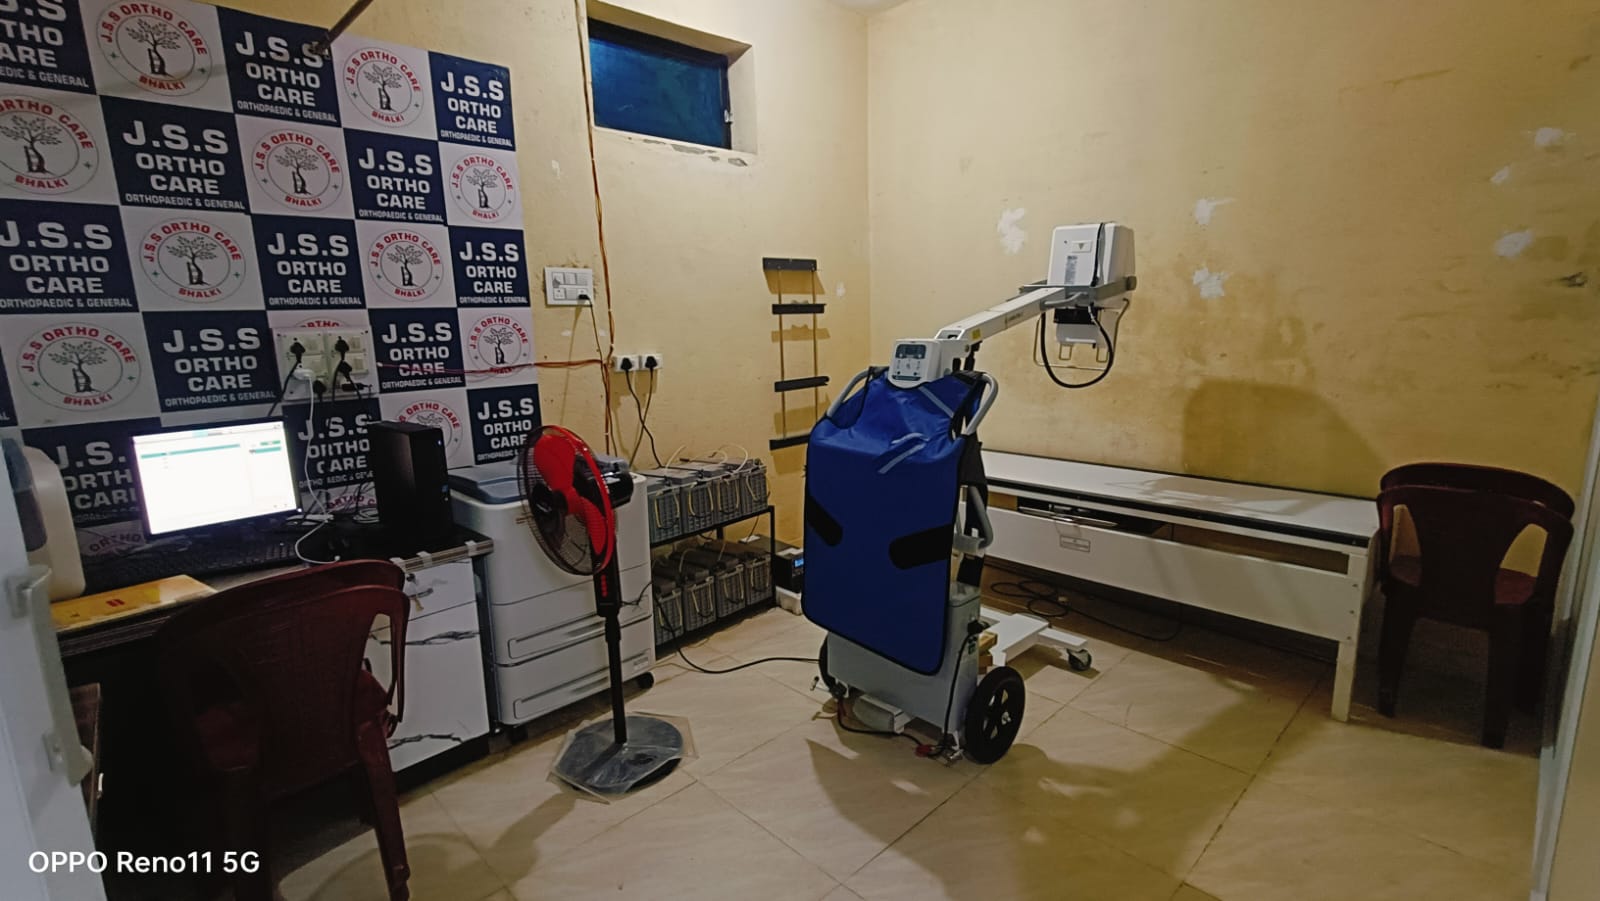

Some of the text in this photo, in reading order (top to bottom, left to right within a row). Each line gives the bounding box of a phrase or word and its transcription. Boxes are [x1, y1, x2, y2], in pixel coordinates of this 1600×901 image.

[0, 19, 63, 46] THO
[120, 4, 173, 21] ORTHO
[178, 21, 207, 55] CARE
[0, 42, 57, 68] ARE
[39, 71, 89, 88] GENERAL
[245, 62, 321, 89] ORTHO
[360, 51, 398, 64] ORTHO
[400, 64, 421, 92] CARE
[139, 75, 186, 90] BHALKI
[440, 72, 504, 101] J.S.S
[257, 84, 316, 107] CARE
[237, 100, 292, 116] ORTHOPAEDIC
[302, 109, 337, 122] GENERAL
[447, 97, 501, 118] ORTHO
[59, 114, 94, 149] CARE
[455, 116, 497, 133] CARE
[122, 120, 229, 154] J.S.S
[488, 137, 512, 147] GENERAL
[271, 132, 313, 146] ORTHO
[316, 144, 340, 173] CARE
[358, 148, 433, 176] J.S.S
[135, 152, 226, 176] ORTHO
[463, 156, 495, 167] ORTHO
[495, 165, 513, 191] CARE
[15, 175, 69, 189] BHALKI
[150, 174, 220, 195] CARE
[366, 174, 430, 194] ORTHO
[125, 193, 194, 207] ORTHOPAEDIC
[204, 199, 245, 210] GENERAL
[284, 195, 322, 207] BHALKI
[376, 193, 426, 210] CARE
[359, 208, 406, 219] ORTHOPAEDIC
[414, 211, 444, 223] GENERAL
[0, 220, 113, 250] J.S.S
[161, 221, 211, 235] ORTHO
[214, 231, 242, 261] CARE
[267, 232, 349, 257] J.S.S
[383, 232, 419, 244] ORTHO
[421, 241, 441, 266] CARE
[459, 241, 519, 263] J.S.S
[8, 255, 110, 273] ORTHO
[277, 261, 347, 277] ORTHO
[465, 265, 518, 279] ORTHO
[25, 276, 104, 294] CARE
[178, 287, 222, 298] BHALKI
[287, 279, 342, 294] CARE
[473, 281, 513, 294] CARE
[0, 299, 75, 308] ORTHOPAEDIC
[86, 298, 133, 308] GENERAL
[269, 297, 322, 306] ORTHOPAEDIC
[329, 296, 362, 305] GENERAL
[163, 327, 261, 353] J.S.S
[382, 322, 452, 343] J.S.S
[481, 316, 510, 328] ORTHO
[512, 323, 528, 344] CARE
[42, 326, 100, 341] ORTHO
[104, 334, 136, 364] CARE
[389, 346, 449, 361] ORTHO
[174, 355, 258, 375] ORTHO
[398, 362, 445, 377] CARE
[187, 373, 253, 392] CARE
[434, 376, 462, 385] GENERAL
[63, 393, 113, 407] BHALKI
[165, 395, 229, 408] ORTHOPAEDIC
[237, 390, 276, 402] GENERAL
[477, 398, 534, 420] J.S.S
[406, 403, 460, 429] ORTHO CARE
[484, 419, 532, 435] ORTHO
[63, 469, 133, 491] ORTH
